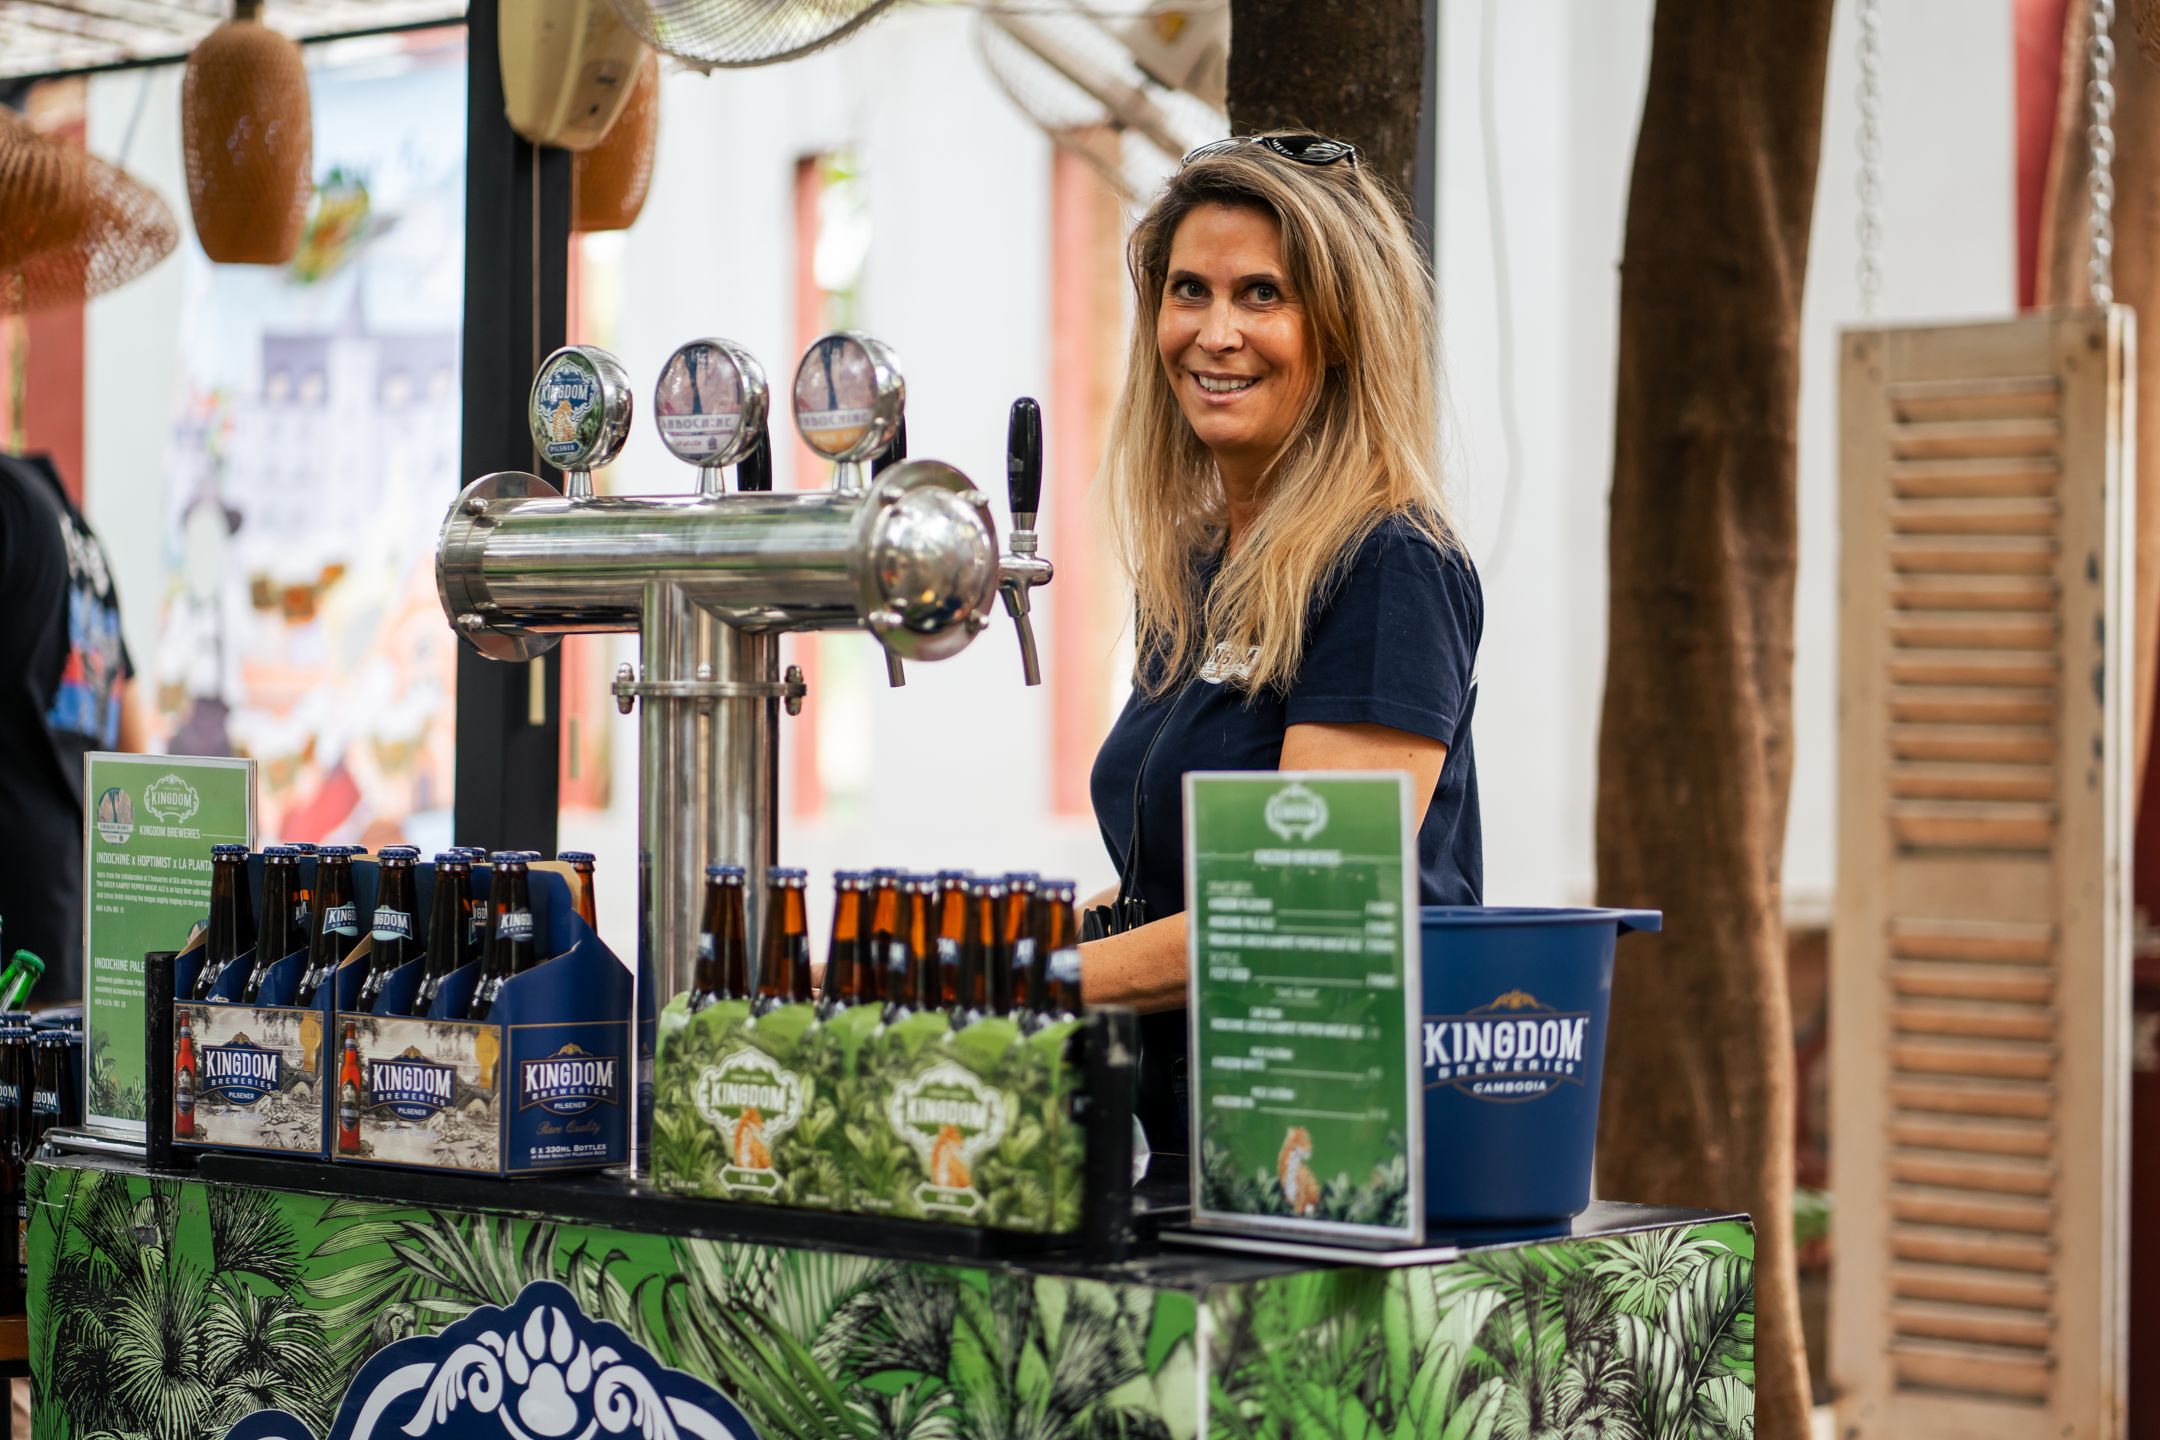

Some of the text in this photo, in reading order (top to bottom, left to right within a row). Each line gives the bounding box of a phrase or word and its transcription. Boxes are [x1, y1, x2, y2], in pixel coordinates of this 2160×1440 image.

[542, 384, 589, 402] KINGDOM
[550, 444, 576, 452] PILSNER
[152, 791, 192, 808] KINGDOM
[140, 824, 200, 840] KINGDOM BREWERIES
[96, 852, 130, 866] INDOCHINE
[138, 854, 171, 868] HOPTIMIST
[178, 858, 187, 870] LA
[328, 909, 356, 924] KINGD
[374, 912, 408, 929] NGDOM
[500, 914, 533, 928] KINGD
[94, 956, 145, 972] INDOCHINE PALE
[1424, 1018, 1584, 1067] KINGDOM
[206, 1050, 278, 1082] KINGDOM
[1438, 1060, 1575, 1080] BREWERIES
[212, 1077, 272, 1090] BREWERIES
[372, 1064, 451, 1099] KINGDOM
[525, 1060, 614, 1092] KINGDOM
[228, 1090, 255, 1100] PILSENER
[532, 1086, 608, 1100] BREWERIES
[1472, 1080, 1547, 1094] CAMBODIA
[378, 1092, 446, 1106] BREWERIES
[710, 1083, 785, 1111] KINGDOM
[397, 1107, 427, 1117] PILSENER
[554, 1102, 587, 1110] PILSENER
[530, 1147, 536, 1155] 6
